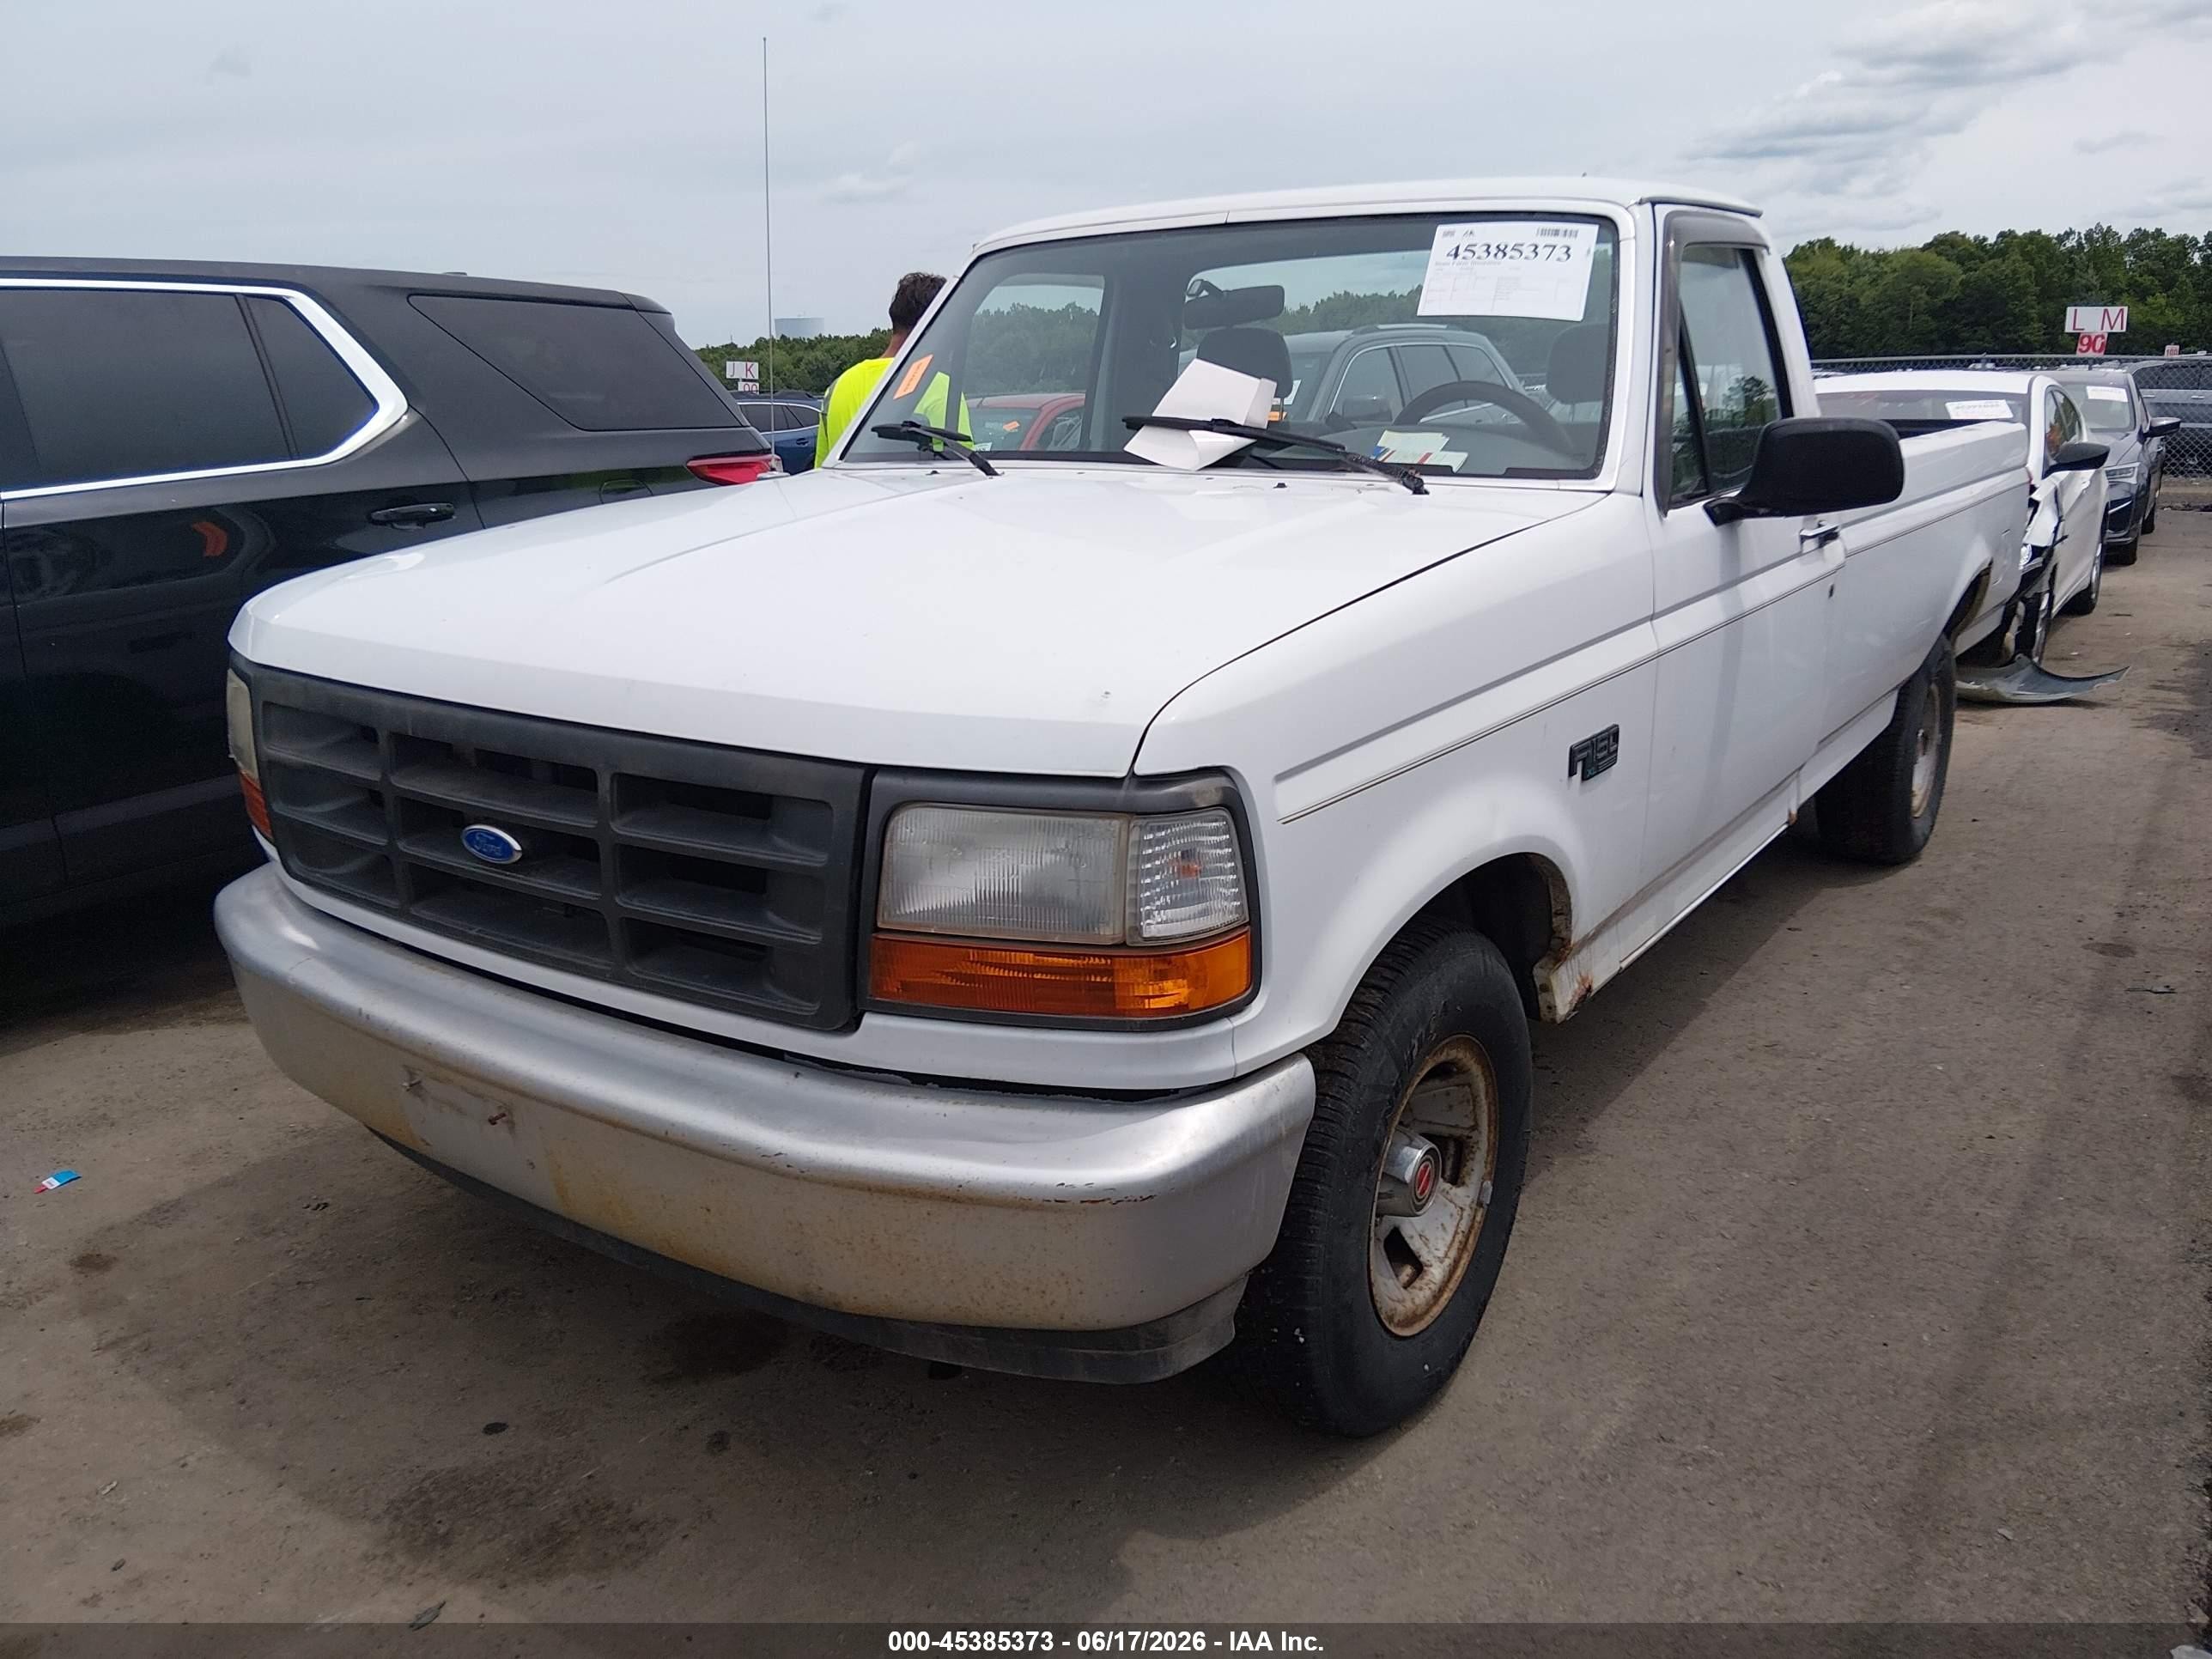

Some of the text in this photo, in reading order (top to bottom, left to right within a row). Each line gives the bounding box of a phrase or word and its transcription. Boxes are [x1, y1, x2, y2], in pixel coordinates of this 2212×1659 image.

[1446, 241, 1571, 263] 45385373
[2072, 307, 2125, 331] L M
[2078, 334, 2106, 354] 90
[730, 362, 756, 379] J K
[473, 833, 503, 857] Ford
